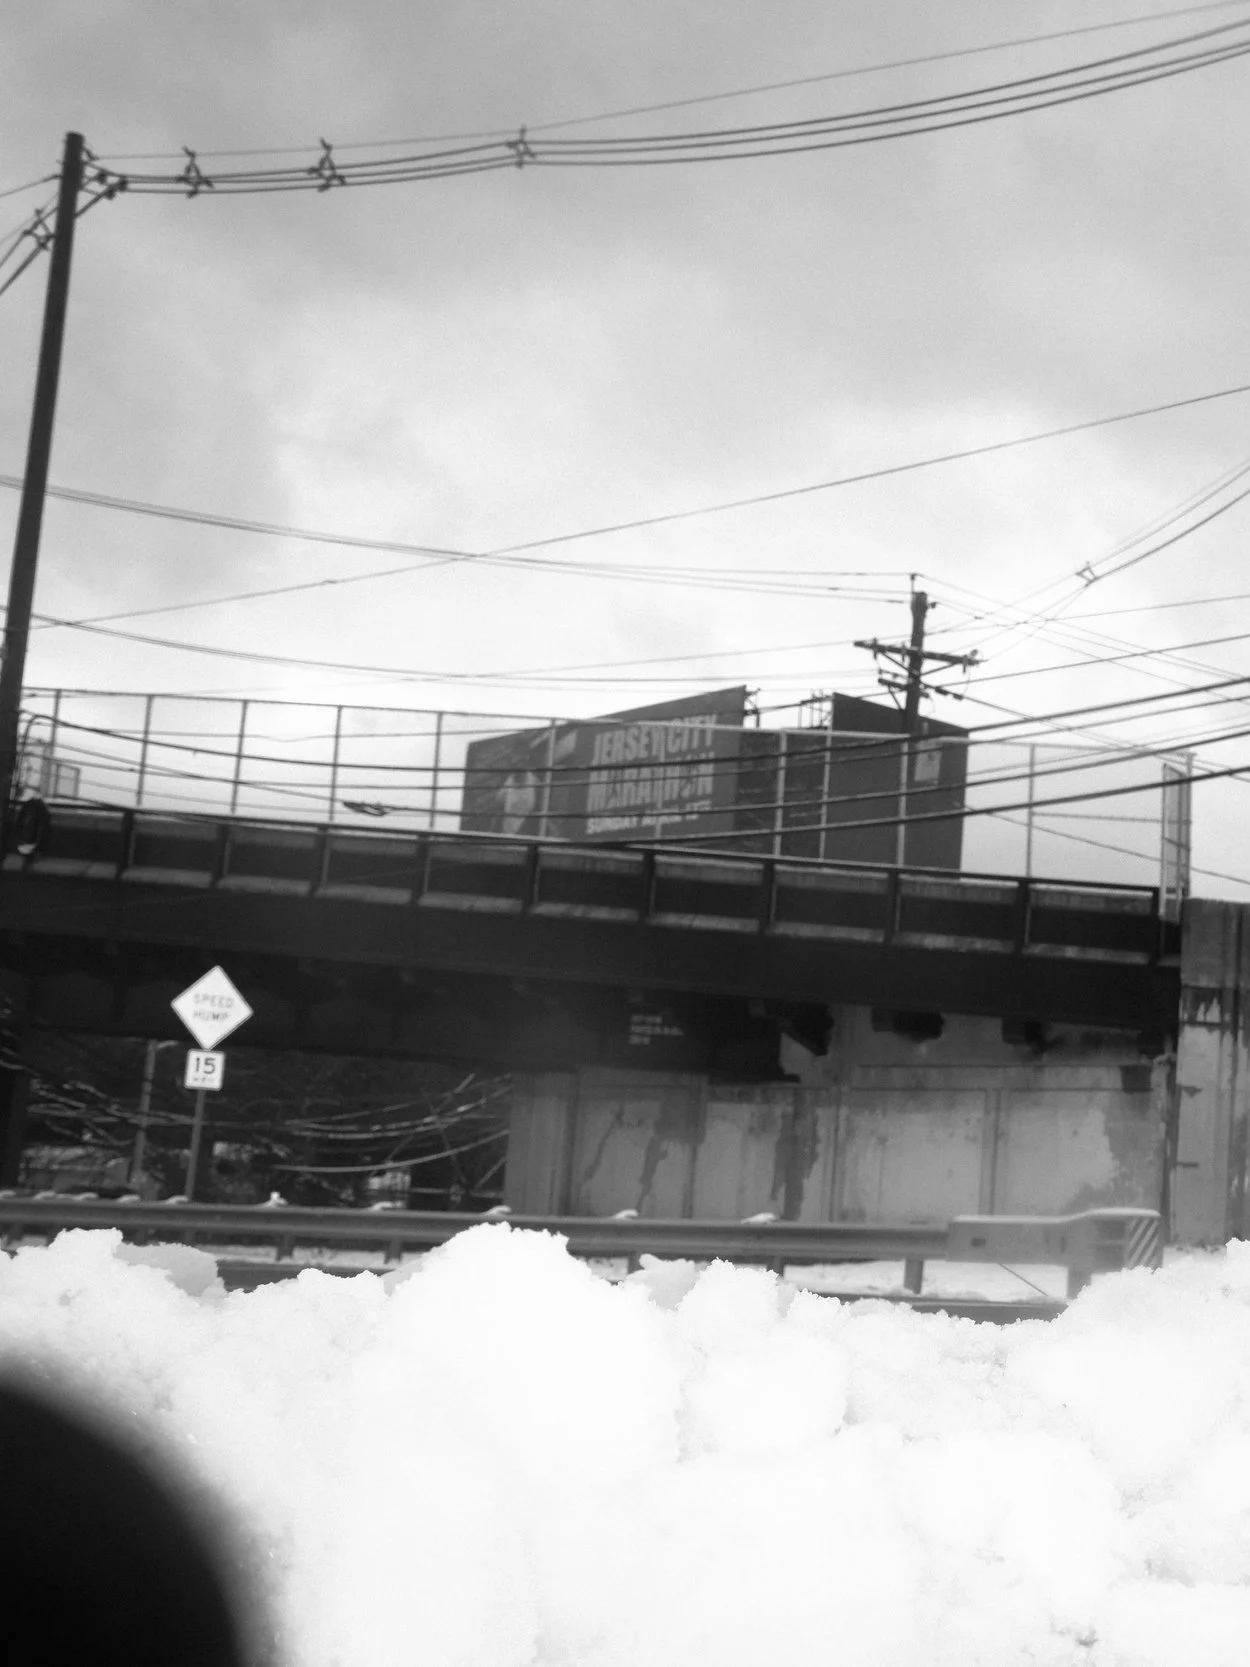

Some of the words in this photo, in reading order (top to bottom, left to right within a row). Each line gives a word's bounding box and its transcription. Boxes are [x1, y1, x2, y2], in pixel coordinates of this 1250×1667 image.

[591, 725, 664, 766] JERSEY
[667, 713, 717, 752] CITY
[587, 752, 714, 812] MARATHON
[193, 993, 234, 1008] SPEED
[193, 1009, 229, 1022] HUMP
[196, 1057, 215, 1074] 15
